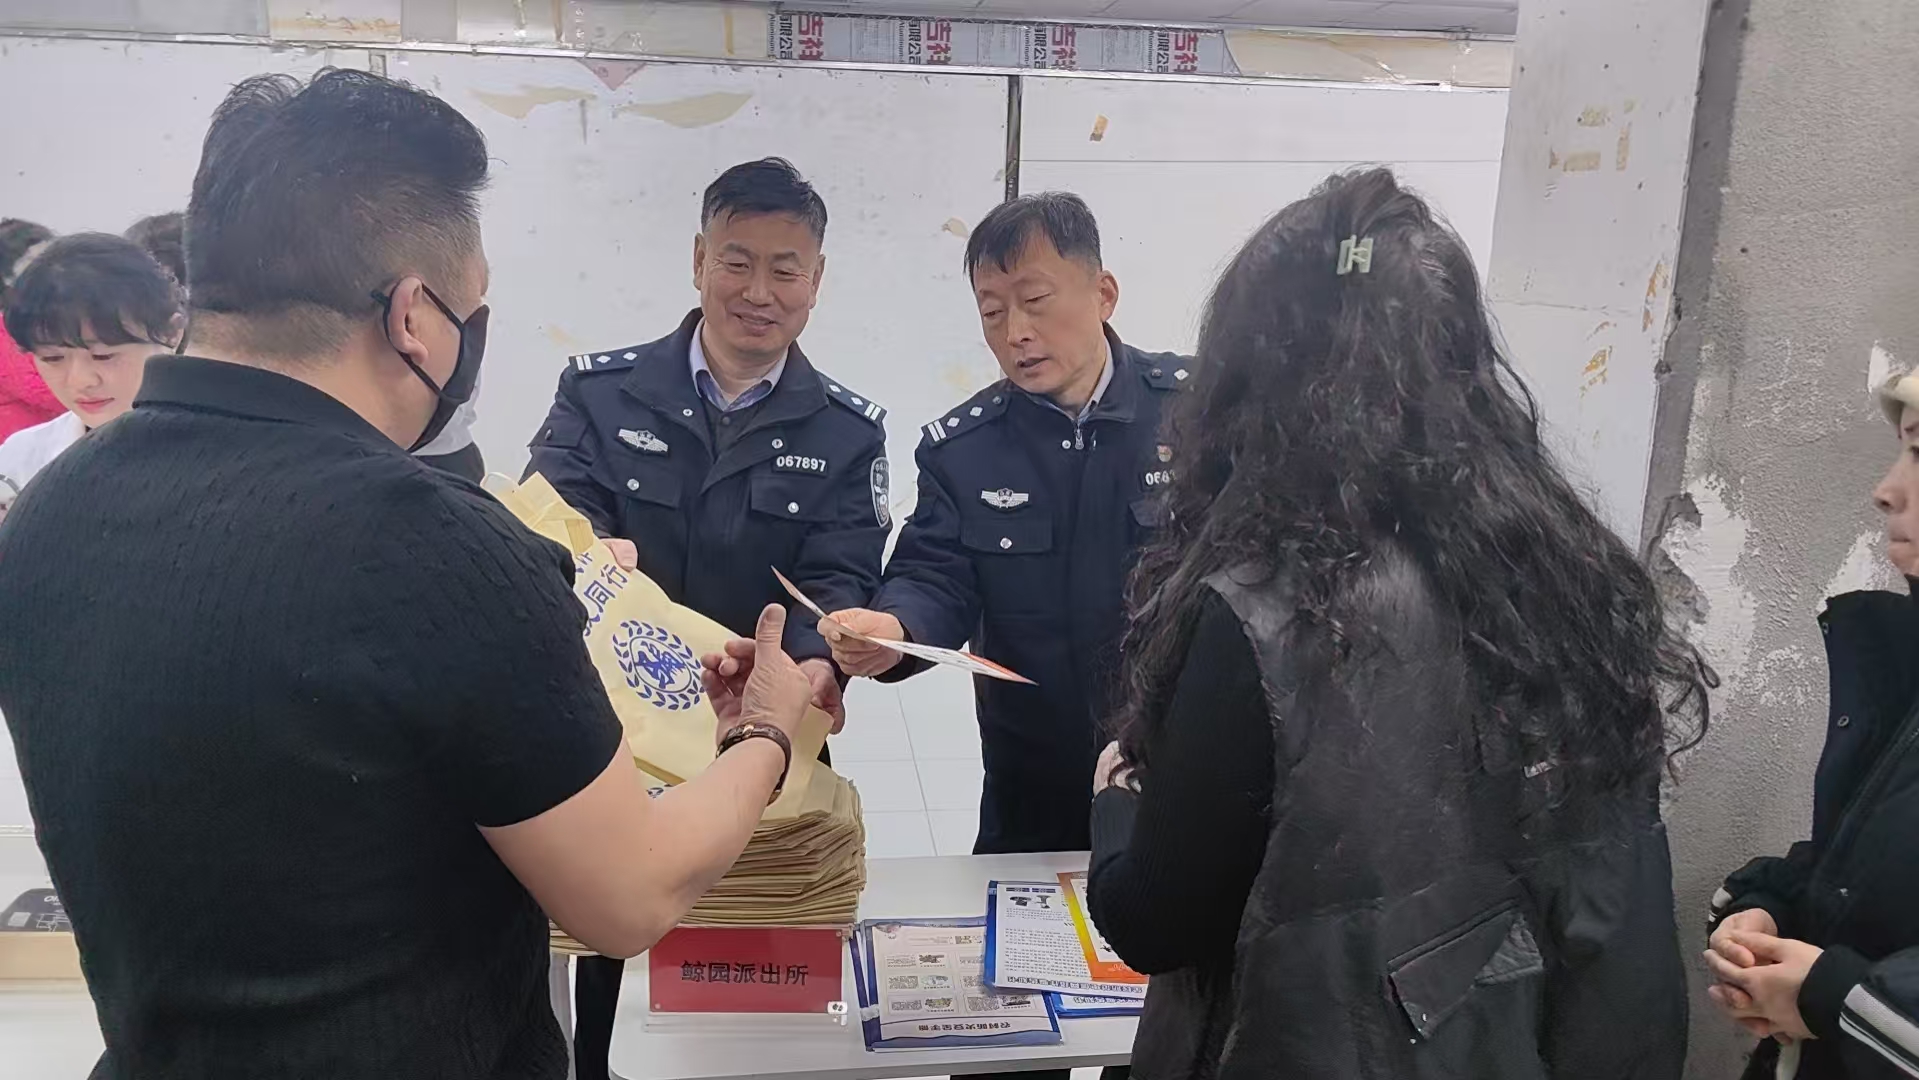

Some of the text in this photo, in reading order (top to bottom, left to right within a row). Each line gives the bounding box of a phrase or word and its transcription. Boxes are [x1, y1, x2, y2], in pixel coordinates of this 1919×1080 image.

[776, 455, 827, 473] 067897
[680, 960, 810, 987] 鲸园派出所
